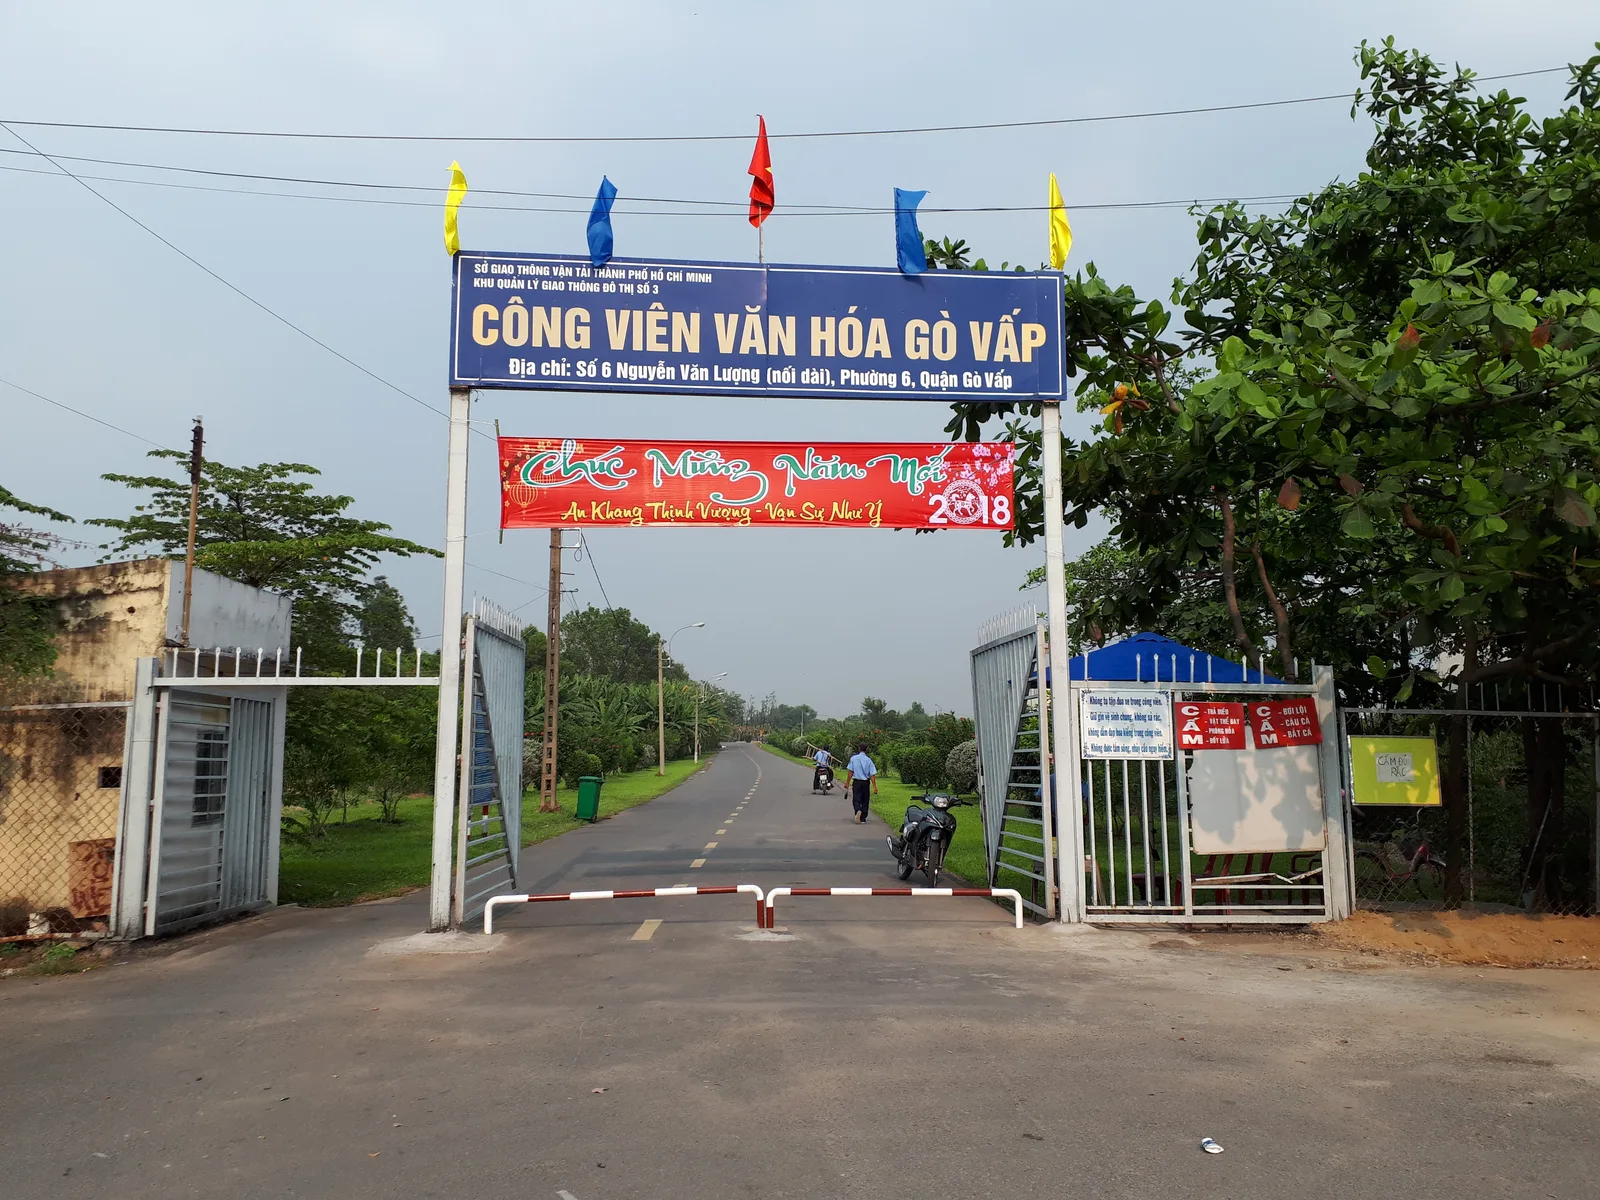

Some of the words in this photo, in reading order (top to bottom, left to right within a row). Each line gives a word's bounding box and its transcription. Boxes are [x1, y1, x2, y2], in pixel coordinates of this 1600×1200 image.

[473, 278, 494, 288] KHU
[497, 276, 525, 290] QUẢN
[527, 278, 539, 290] LÝ
[541, 281, 565, 291] GIAO
[567, 280, 600, 292] THÔNG
[602, 281, 616, 293] ĐÔ
[618, 283, 634, 295] THỊ
[637, 281, 650, 294] SỐ
[652, 285, 659, 294] 3
[474, 260, 489, 274] SỞ
[491, 264, 514, 275] GIAO
[517, 263, 549, 276] THÔNG
[552, 265, 573, 278] VẬN
[575, 264, 591, 277] TẢI
[594, 266, 626, 279] THÀNH
[628, 267, 648, 280] PHỐ
[650, 268, 664, 281] HỒ
[666, 270, 683, 282] CHÍ
[686, 272, 712, 283] MINH
[472, 296, 591, 350] CÔNG
[605, 302, 701, 354] VIÊN
[714, 305, 796, 357] VĂN
[810, 305, 892, 359] HÓA
[905, 311, 957, 361] GÒ
[969, 308, 1047, 363] VẤP
[509, 358, 535, 378] Địa
[541, 357, 571, 377] chỉ:
[576, 357, 599, 378] Số
[601, 362, 612, 378] 6
[616, 361, 675, 381] Nguyễn
[680, 364, 709, 381] Văn
[714, 365, 760, 385] Lượng
[766, 366, 796, 385] (nối
[801, 368, 835, 387] dài),
[840, 370, 897, 389] Phường
[901, 371, 916, 388] 6,
[920, 371, 958, 391] Quận
[962, 372, 982, 388] Gò
[984, 369, 1013, 390] Vấp
[520, 438, 637, 490] Chúc
[645, 448, 769, 505] Mừng
[773, 447, 866, 497] Năm
[866, 445, 955, 496] Mới
[561, 502, 586, 521] An
[591, 501, 643, 526] Khang
[645, 502, 694, 522] Thịnh
[696, 502, 752, 526] Vượng
[765, 503, 796, 521] Vạn
[800, 502, 825, 521] Sự
[829, 503, 862, 521] Như
[865, 500, 883, 527] Ý
[1181, 705, 1204, 745] CẤM
[1256, 706, 1278, 745] CẤM
[1391, 766, 1406, 777] RÁC
